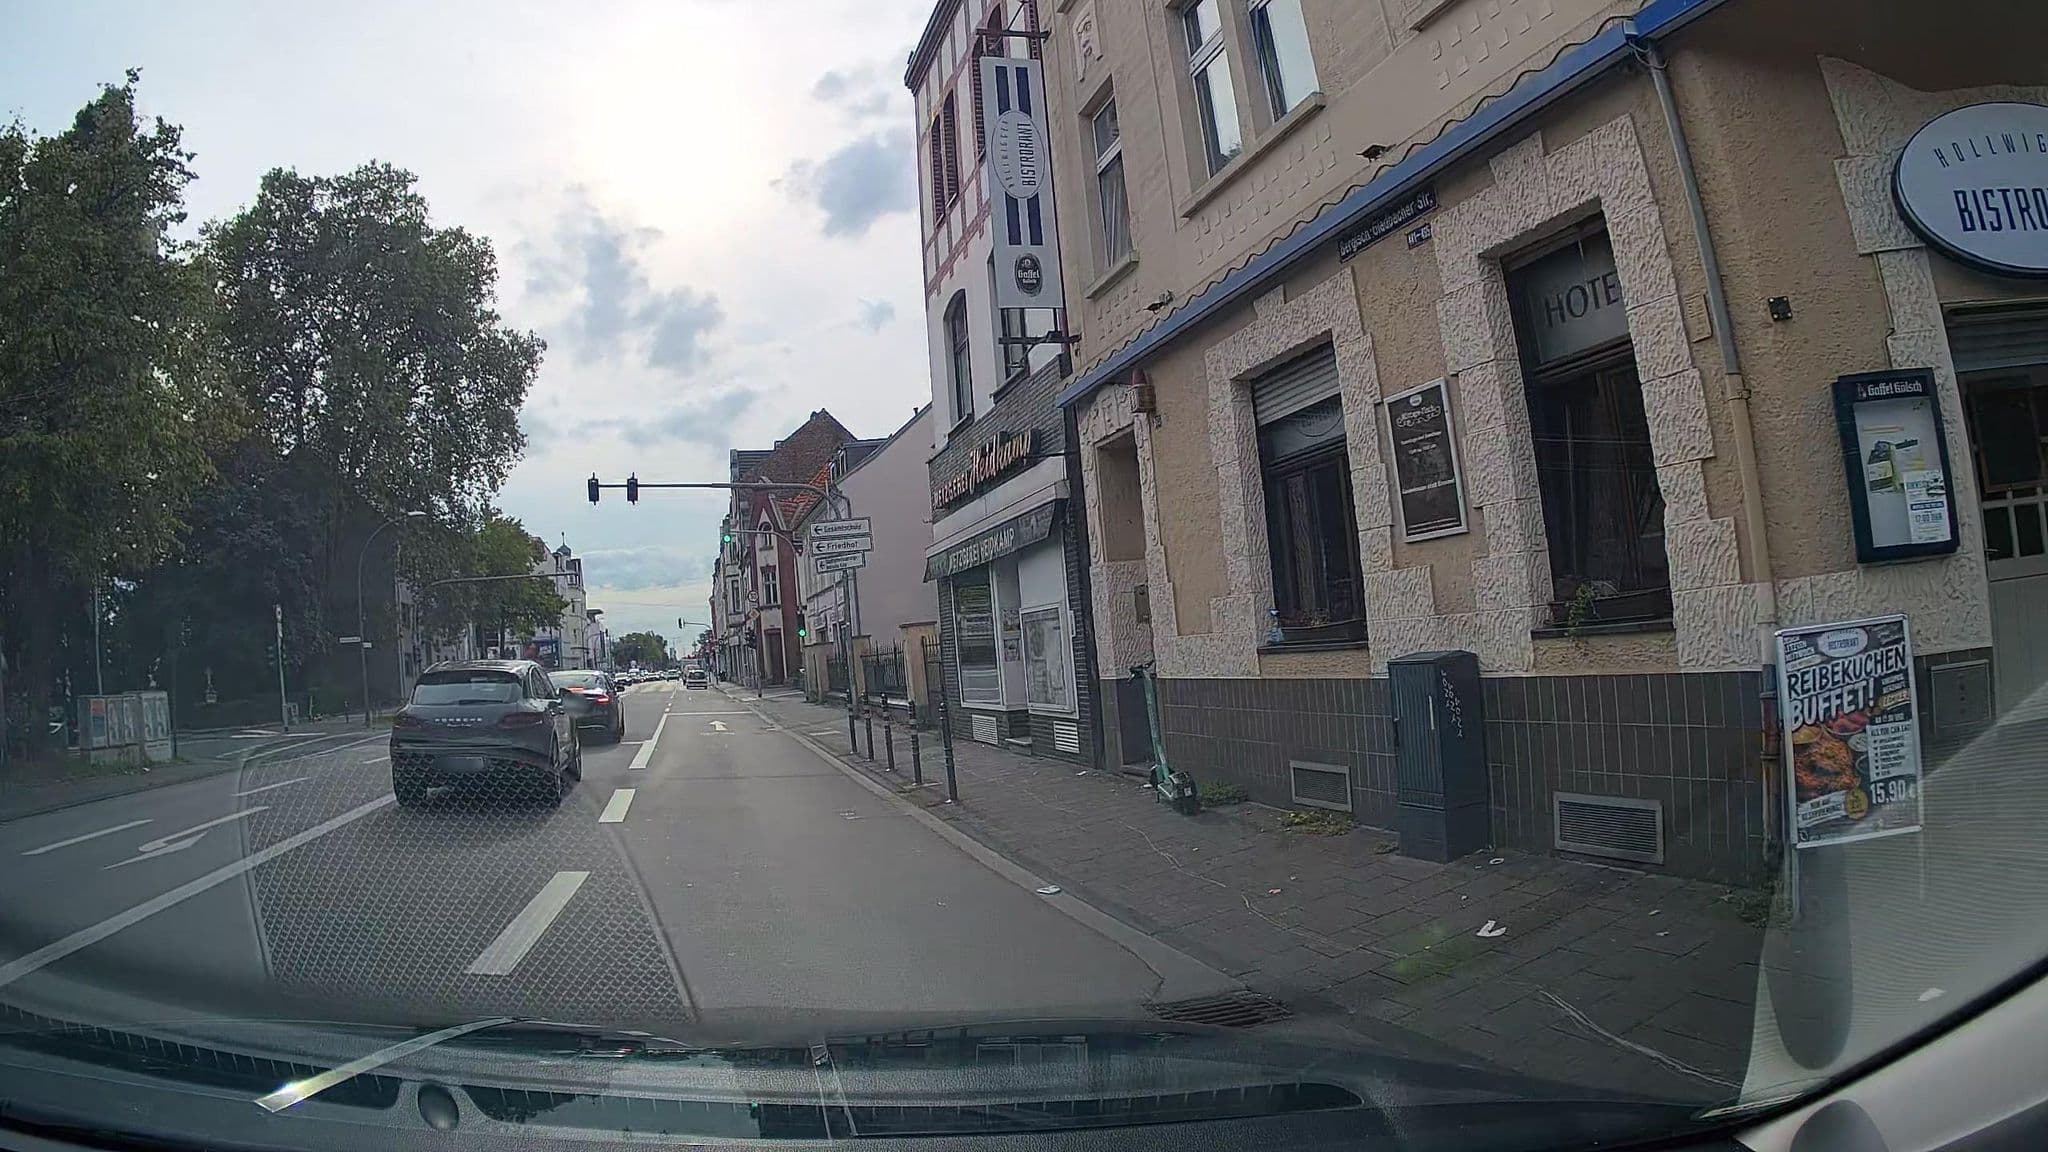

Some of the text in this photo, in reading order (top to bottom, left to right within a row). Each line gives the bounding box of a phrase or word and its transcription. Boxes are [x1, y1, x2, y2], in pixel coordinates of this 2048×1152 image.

[1017, 123, 1037, 186] BISTRORANT
[1954, 188, 2048, 232] BISTRO
[1868, 382, 1895, 396] Gaffel
[827, 541, 858, 550] Friedhof
[1787, 642, 1906, 699] REIBEKUCHEN
[1790, 677, 1875, 732] BUFFET!
[1870, 779, 1906, 804] 15,90
